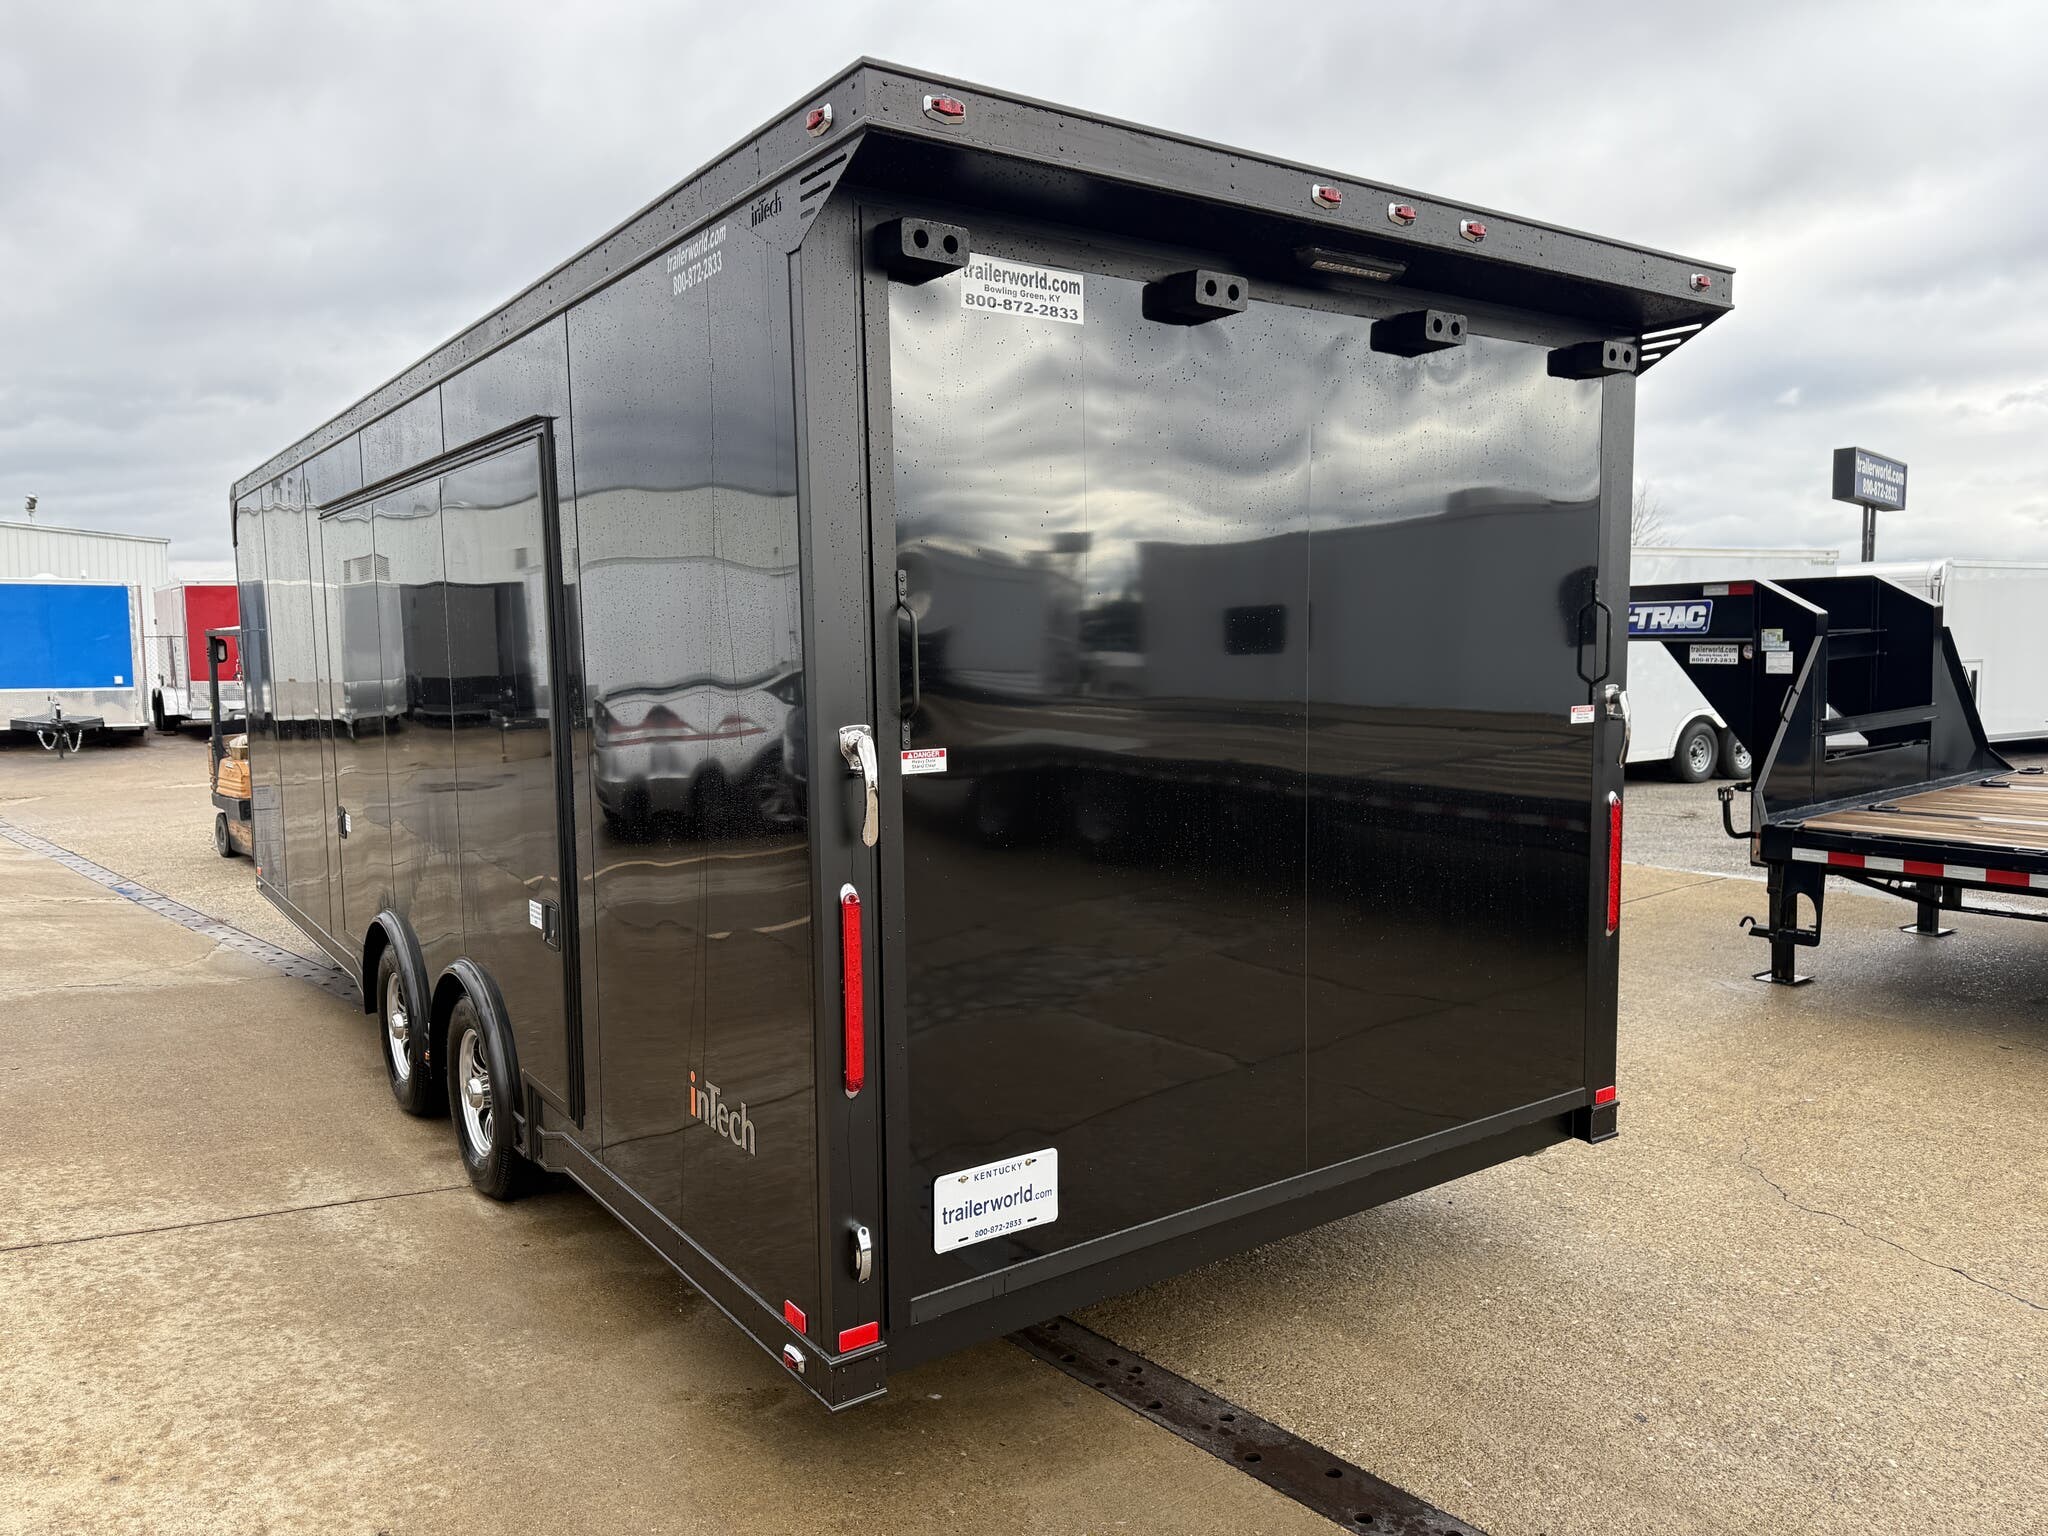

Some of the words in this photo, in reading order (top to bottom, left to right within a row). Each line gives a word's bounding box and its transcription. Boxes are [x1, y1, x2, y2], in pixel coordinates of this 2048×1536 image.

[751, 190, 782, 228] inTech
[667, 225, 727, 275] trailerworld.com
[673, 250, 722, 296] 800-872-2833
[963, 262, 1081, 296] trailerworld.com
[965, 293, 1079, 321] 800-872-2833
[984, 284, 1018, 298] Bowling
[1020, 289, 1047, 302] Green,
[1049, 294, 1061, 303] KY
[1856, 455, 1905, 486] trailerworld.com
[1862, 477, 1898, 502] 800-872-2833
[1628, 605, 1707, 630] -TRAC
[913, 750, 940, 759] DANGER
[690, 1070, 756, 1157] inTech
[973, 1162, 1023, 1182] KENTUCKY
[942, 1183, 1053, 1225] trailerworld.com
[974, 1218, 1022, 1238] 800-872-2833
